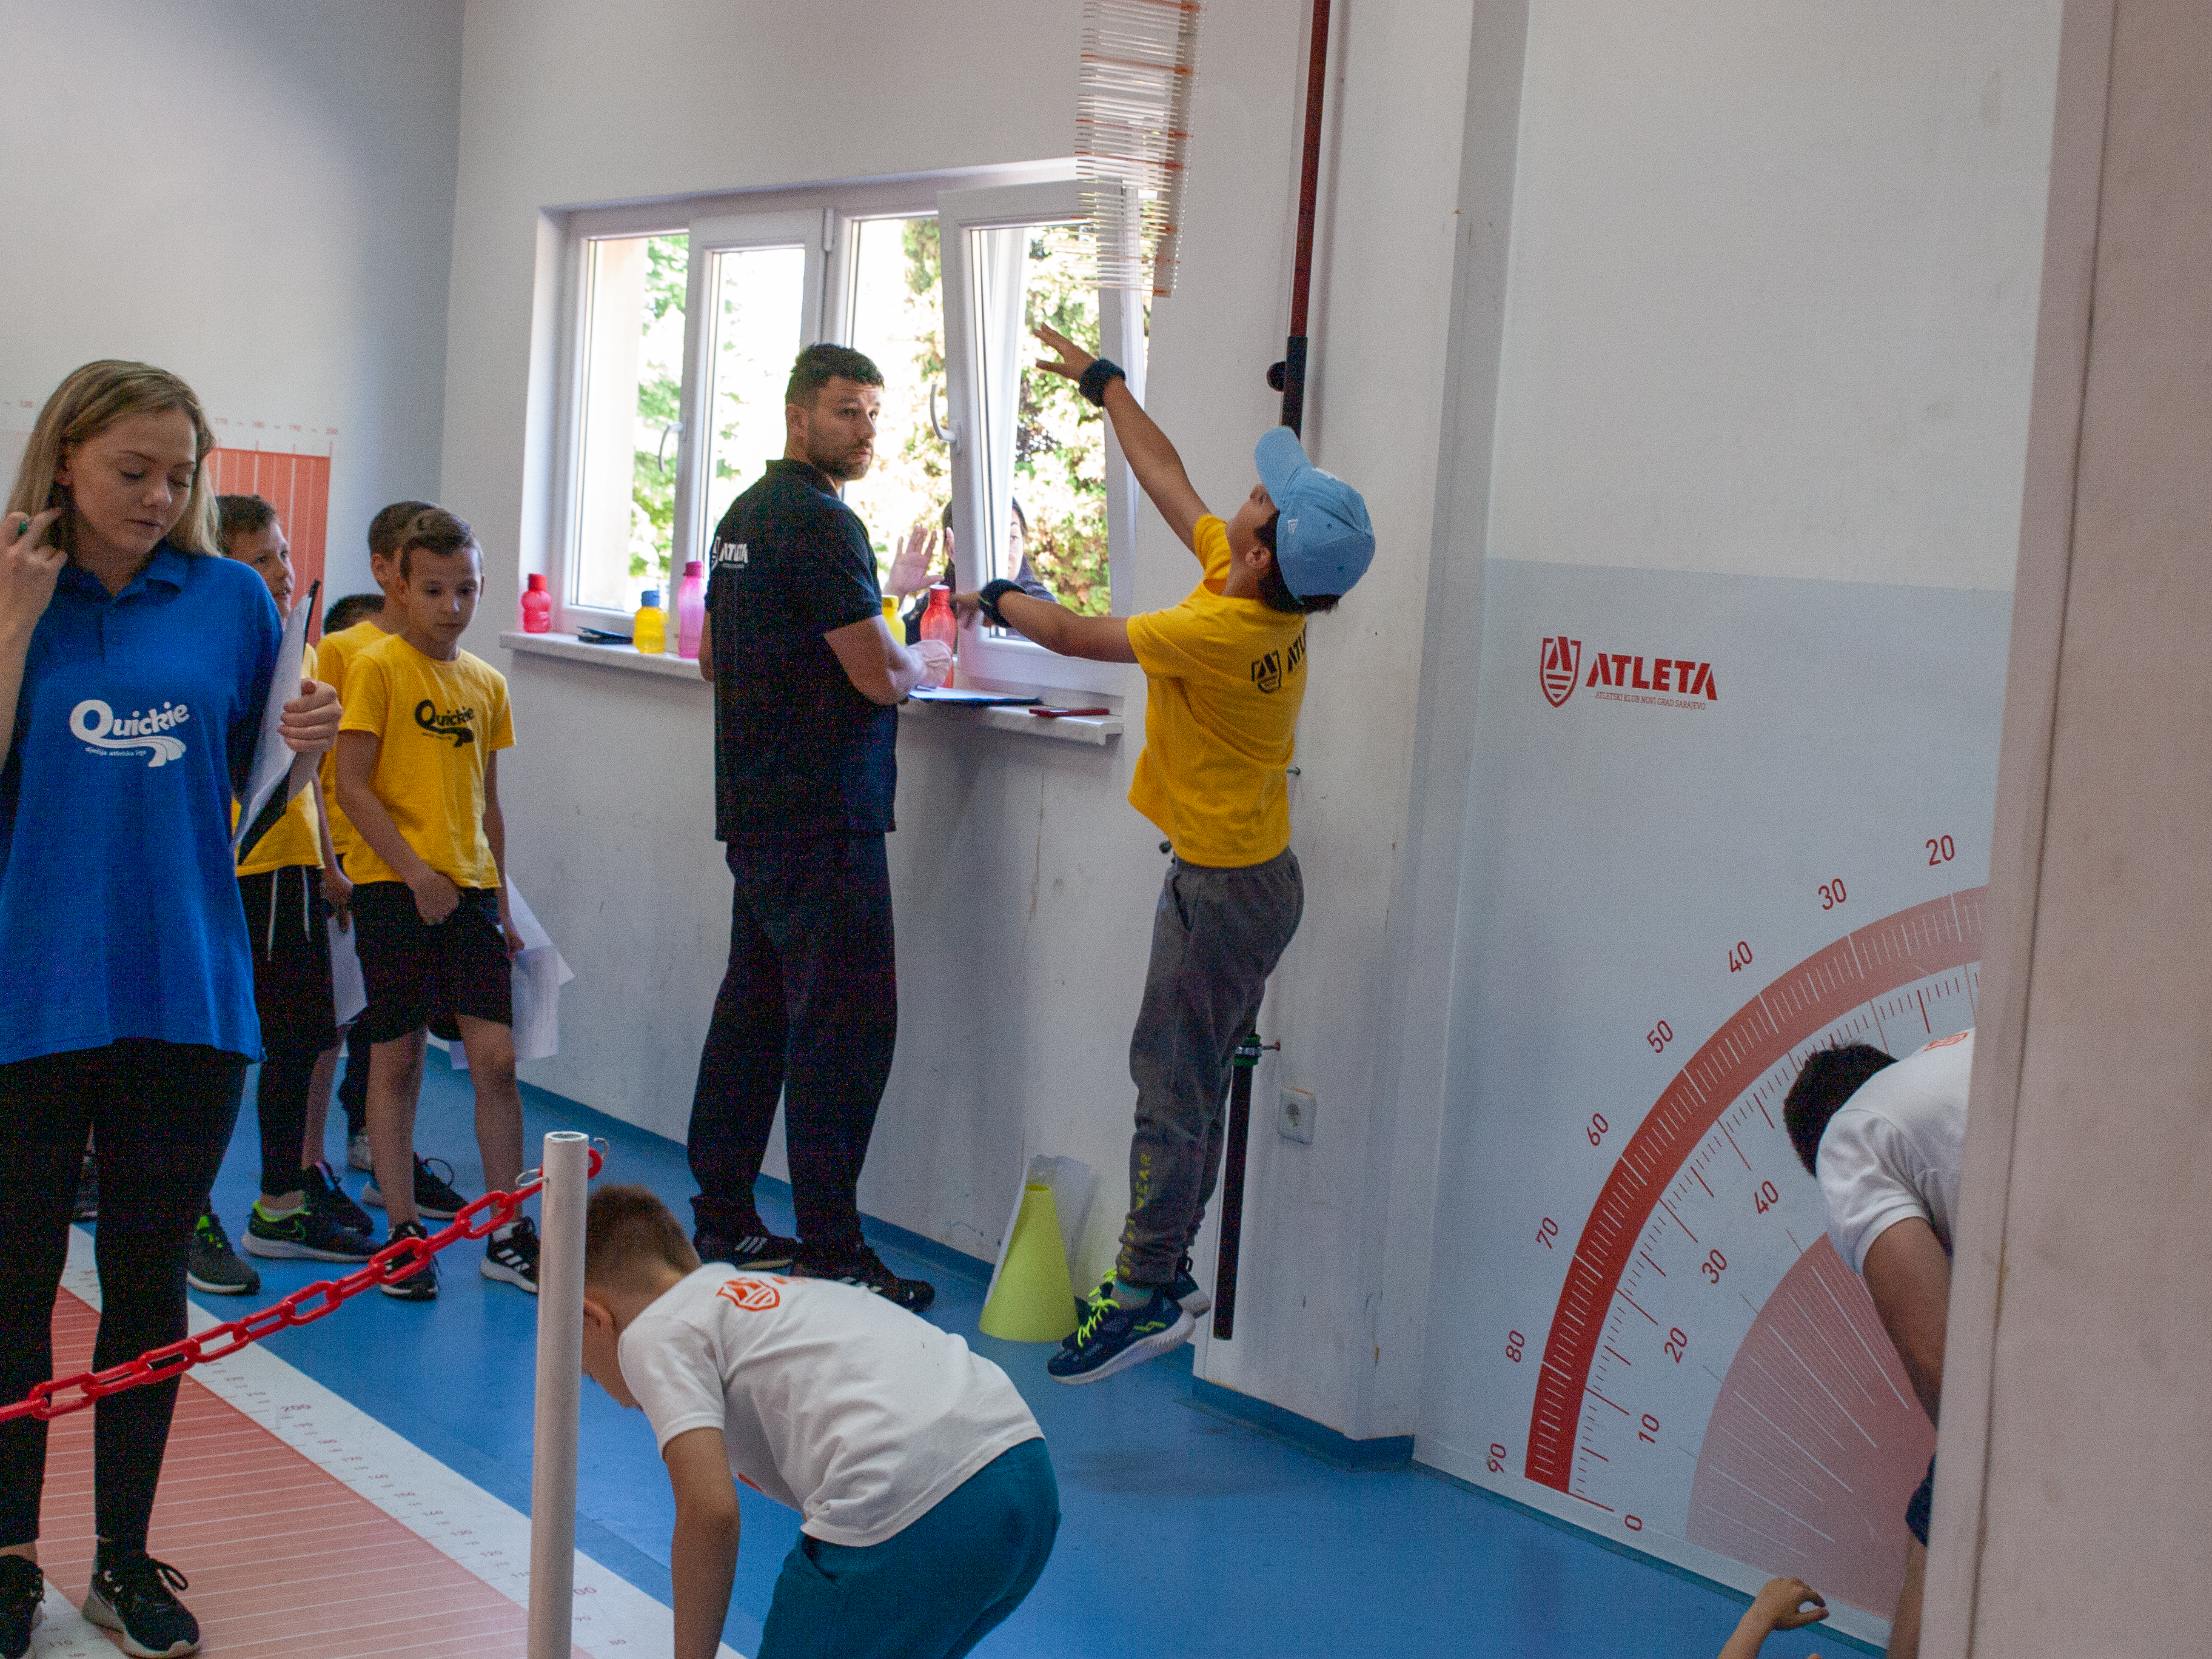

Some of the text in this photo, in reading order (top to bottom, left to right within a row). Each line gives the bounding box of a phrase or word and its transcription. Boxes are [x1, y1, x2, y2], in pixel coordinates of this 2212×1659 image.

[1585, 652, 1718, 701] ATLETA
[69, 699, 190, 759] Quickie
[414, 699, 475, 745] Quickie
[1926, 835, 1955, 866] 20
[1818, 877, 1846, 910] 30
[1728, 941, 1753, 973] 40
[1647, 1020, 1673, 1054] 50
[1586, 1113, 1609, 1147] 60
[1754, 1181, 1778, 1214] 40
[1536, 1217, 1558, 1249] 70
[1701, 1248, 1727, 1284] 30
[1506, 1330, 1525, 1362] 80
[1663, 1327, 1687, 1364] 20
[1638, 1413, 1659, 1444] 10
[1487, 1443, 1506, 1472] 90
[1624, 1514, 1642, 1531] 0
[572, 1586, 597, 1595] 00
